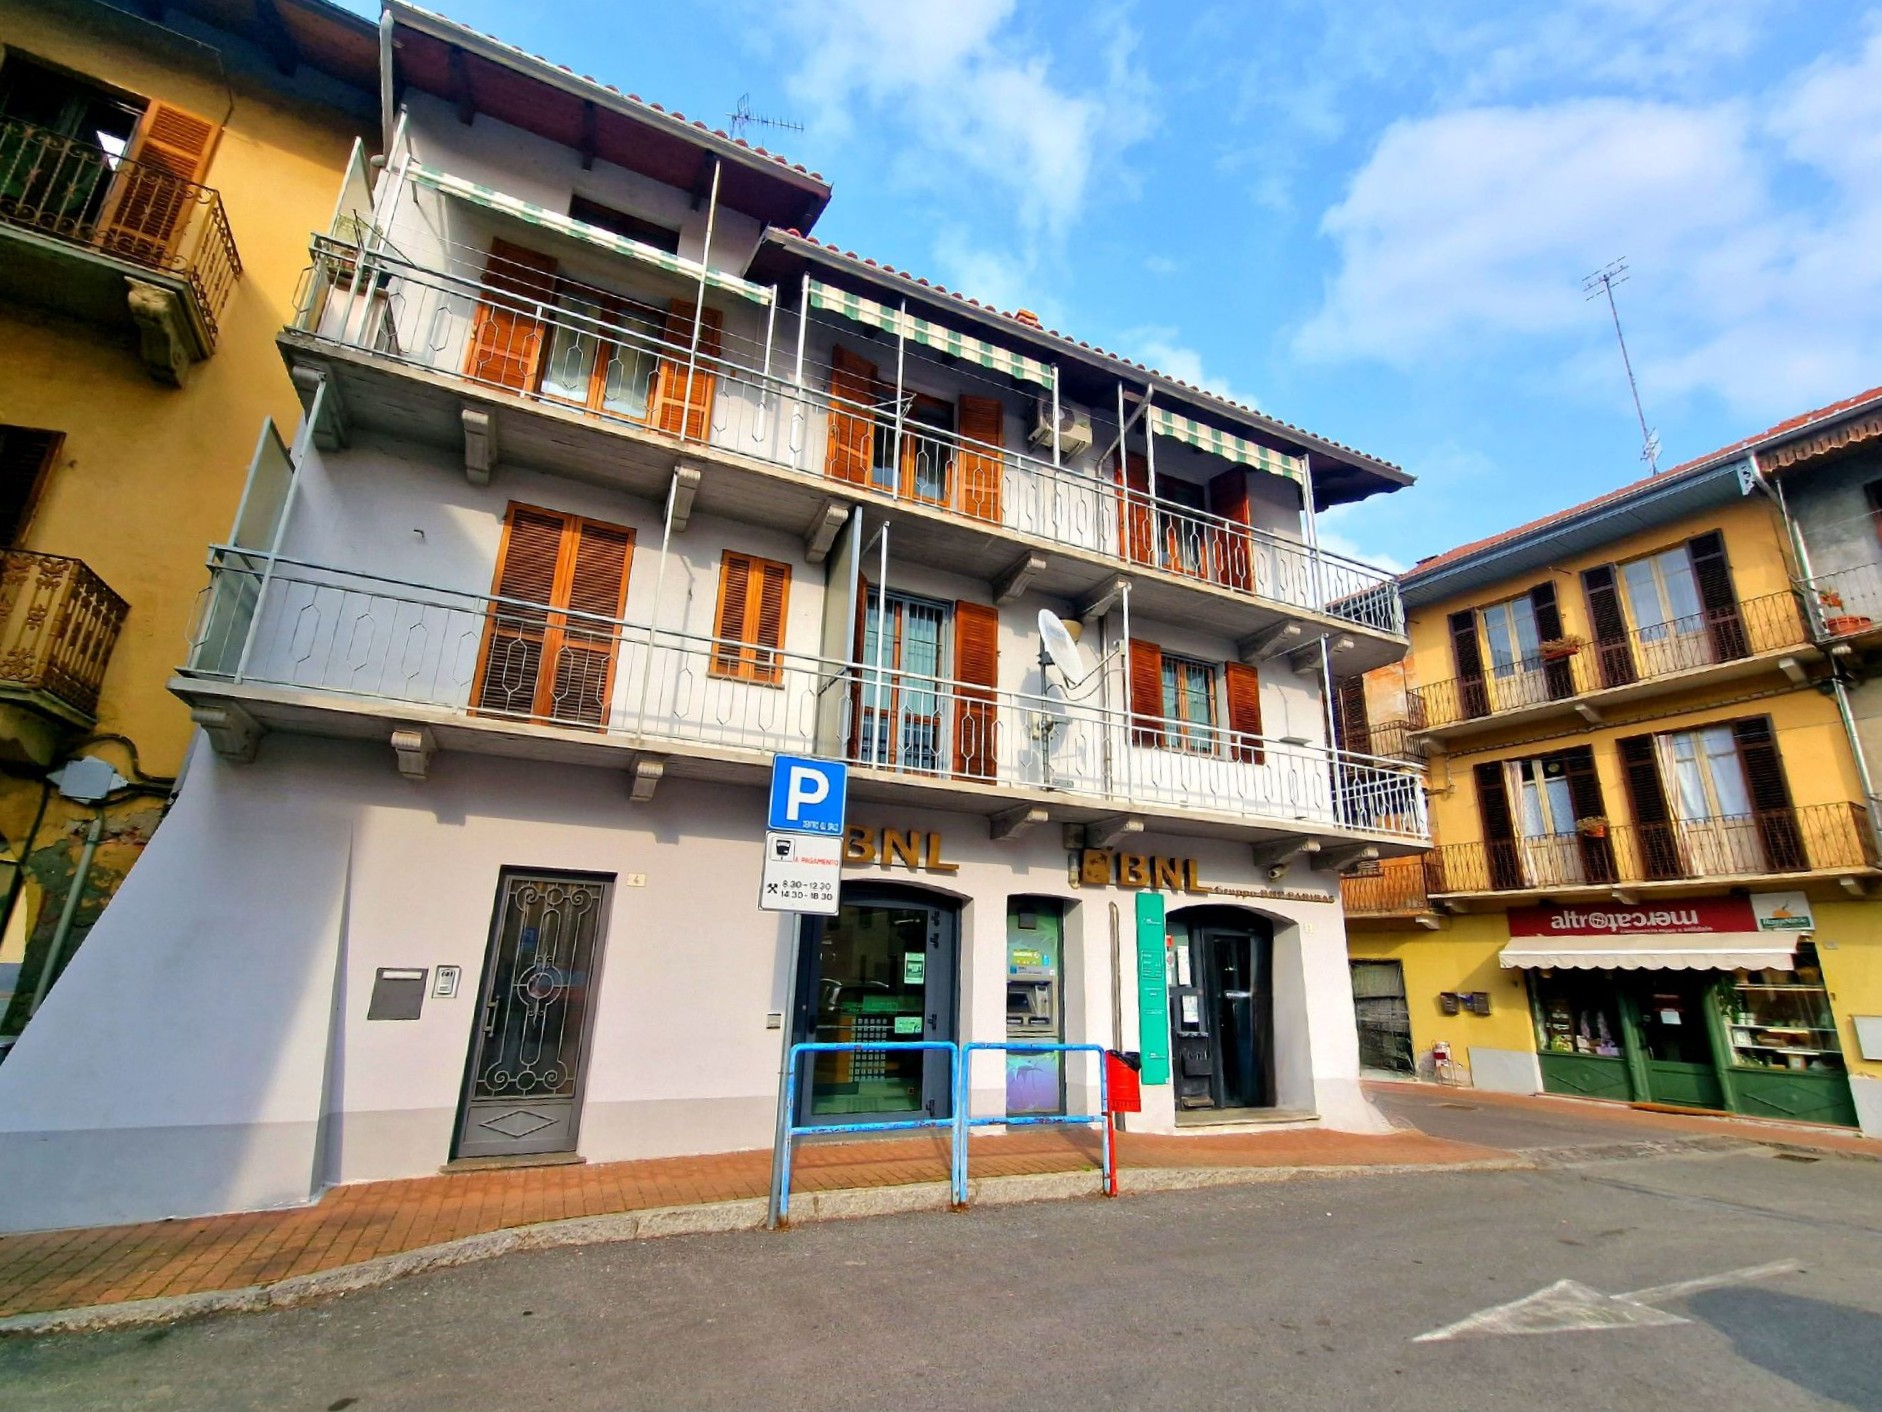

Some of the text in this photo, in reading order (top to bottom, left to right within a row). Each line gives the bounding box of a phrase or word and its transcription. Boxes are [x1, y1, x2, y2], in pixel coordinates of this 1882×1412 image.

[786, 766, 830, 821] P
[801, 856, 839, 866] PAGAMENTO
[843, 824, 960, 871] BNL
[1116, 851, 1212, 893] BNL
[1213, 886, 1256, 899] Gruppo
[1287, 892, 1335, 903] PARIBAS
